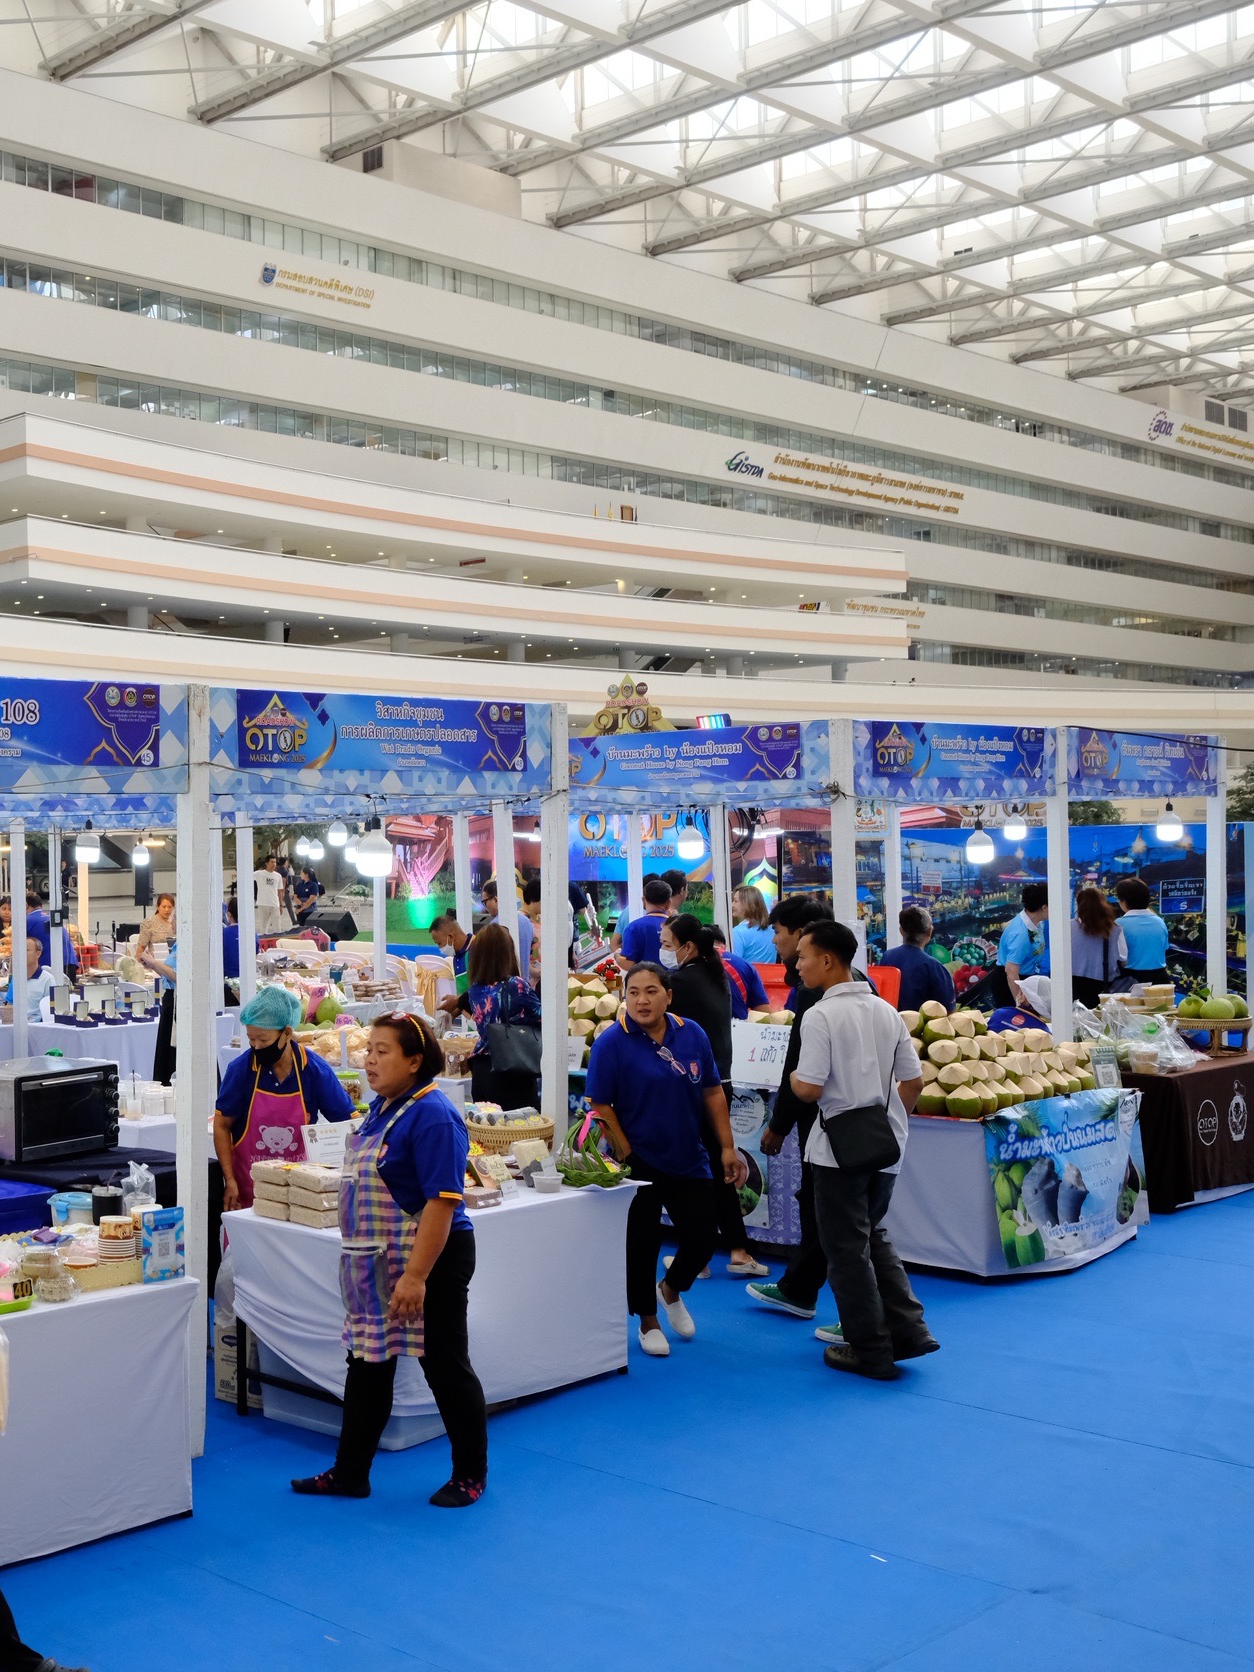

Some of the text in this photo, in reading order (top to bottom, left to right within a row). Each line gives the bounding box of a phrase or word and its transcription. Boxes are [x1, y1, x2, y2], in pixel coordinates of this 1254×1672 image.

[278, 269, 375, 300] กรมสอบสวนคดีพิเศษ (DSI)
[276, 282, 308, 295] DEPARTMENT
[317, 291, 336, 301] SPECIAL
[337, 296, 372, 309] INVESTIGATION
[2, 699, 39, 725] 108
[606, 697, 649, 708] ROADSHOW
[257, 716, 295, 727] ROADSHOW
[375, 700, 445, 727] วิสาหกิจชุมชน
[593, 706, 662, 731] OTOP
[246, 727, 307, 753] OTOP
[340, 721, 478, 743] การผลิตการเกษตรปลอดสาร
[380, 743, 443, 757] Wat Pradu Organic
[606, 744, 661, 762] บ้านมะพร้าว
[664, 745, 678, 760] by
[680, 740, 743, 758] น้องแป้งหอม
[969, 738, 978, 752] by
[249, 753, 290, 764] MAEKLONG
[620, 758, 729, 771] Coconut House by Nong Pang Hom
[877, 747, 915, 766] OTOP
[1081, 751, 1110, 768] OTOP
[787, 768, 796, 778] 49
[650, 845, 675, 858] 2025
[748, 1046, 757, 1063] 1
[759, 1044, 778, 1064] แก้ว
[1198, 1117, 1217, 1130] OTOP
[999, 1111, 1118, 1161] น้ำมะพ้าวปั่นนมสด
[13, 1280, 33, 1299] 40
